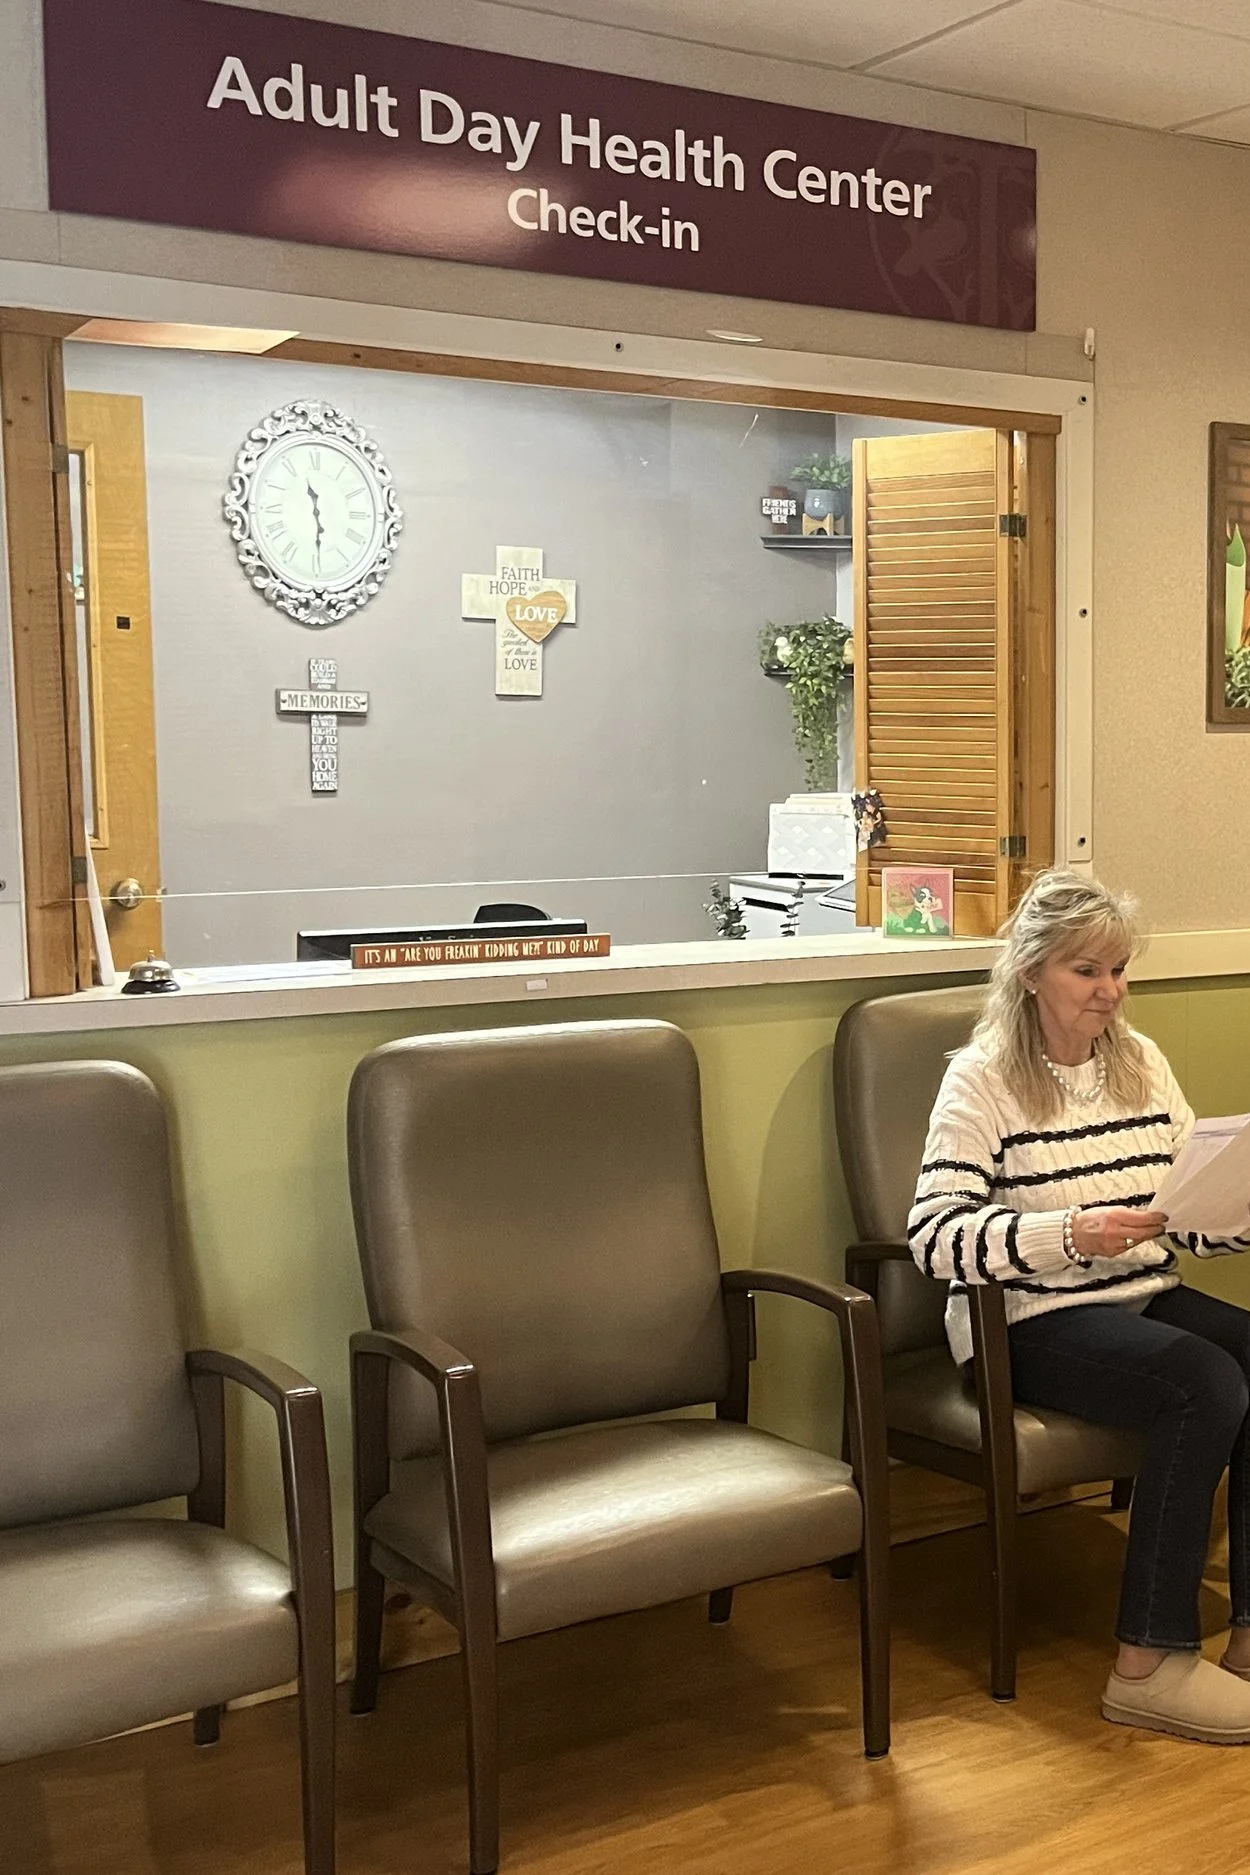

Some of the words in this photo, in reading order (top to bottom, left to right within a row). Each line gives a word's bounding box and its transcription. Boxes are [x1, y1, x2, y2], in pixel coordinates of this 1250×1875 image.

[207, 56, 399, 139] Adult
[419, 89, 541, 172] Day
[560, 113, 745, 191] Health
[763, 149, 932, 219] Center
[507, 187, 699, 252] Check-in
[501, 566, 540, 581] FAITH
[489, 581, 528, 596] HOPE
[515, 604, 558, 623] LOVE
[504, 658, 537, 670] LOVE
[287, 693, 361, 709] MEMORIES
[312, 735, 323, 745] UP
[325, 735, 338, 745] TO
[312, 759, 337, 771] YOU
[312, 771, 337, 781] HOME
[312, 781, 338, 791] AGAIN
[384, 948, 397, 963] AN
[423, 946, 441, 961] YOU
[485, 942, 519, 958] KIDDING
[547, 940, 566, 955] KIND
[569, 939, 581, 954] OF
[583, 938, 600, 953] DAY
